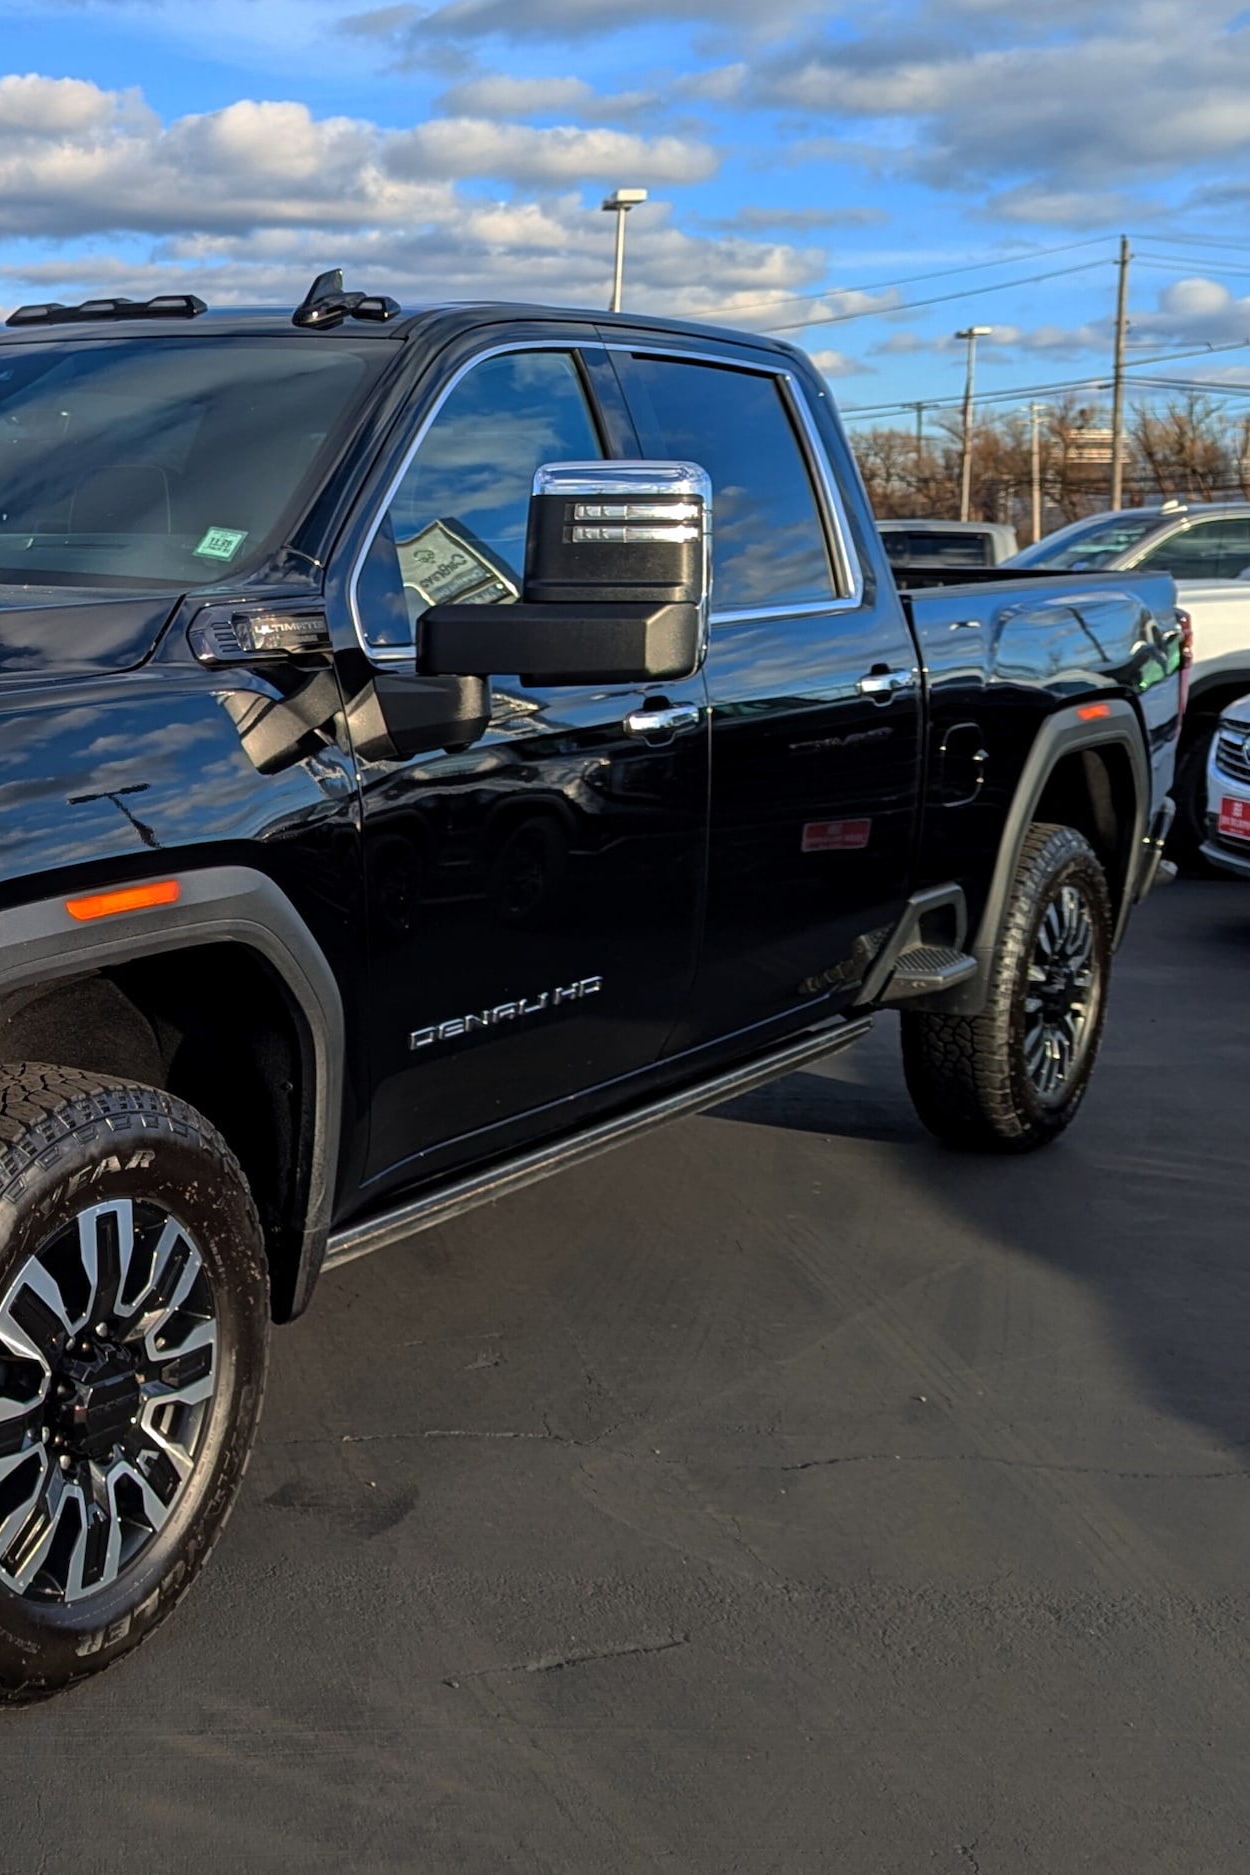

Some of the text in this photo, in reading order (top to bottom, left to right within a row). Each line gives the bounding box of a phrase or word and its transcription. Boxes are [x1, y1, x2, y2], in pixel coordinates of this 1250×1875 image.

[253, 621, 325, 635] ULTIMATE
[409, 975, 603, 1051] DENALI HD
